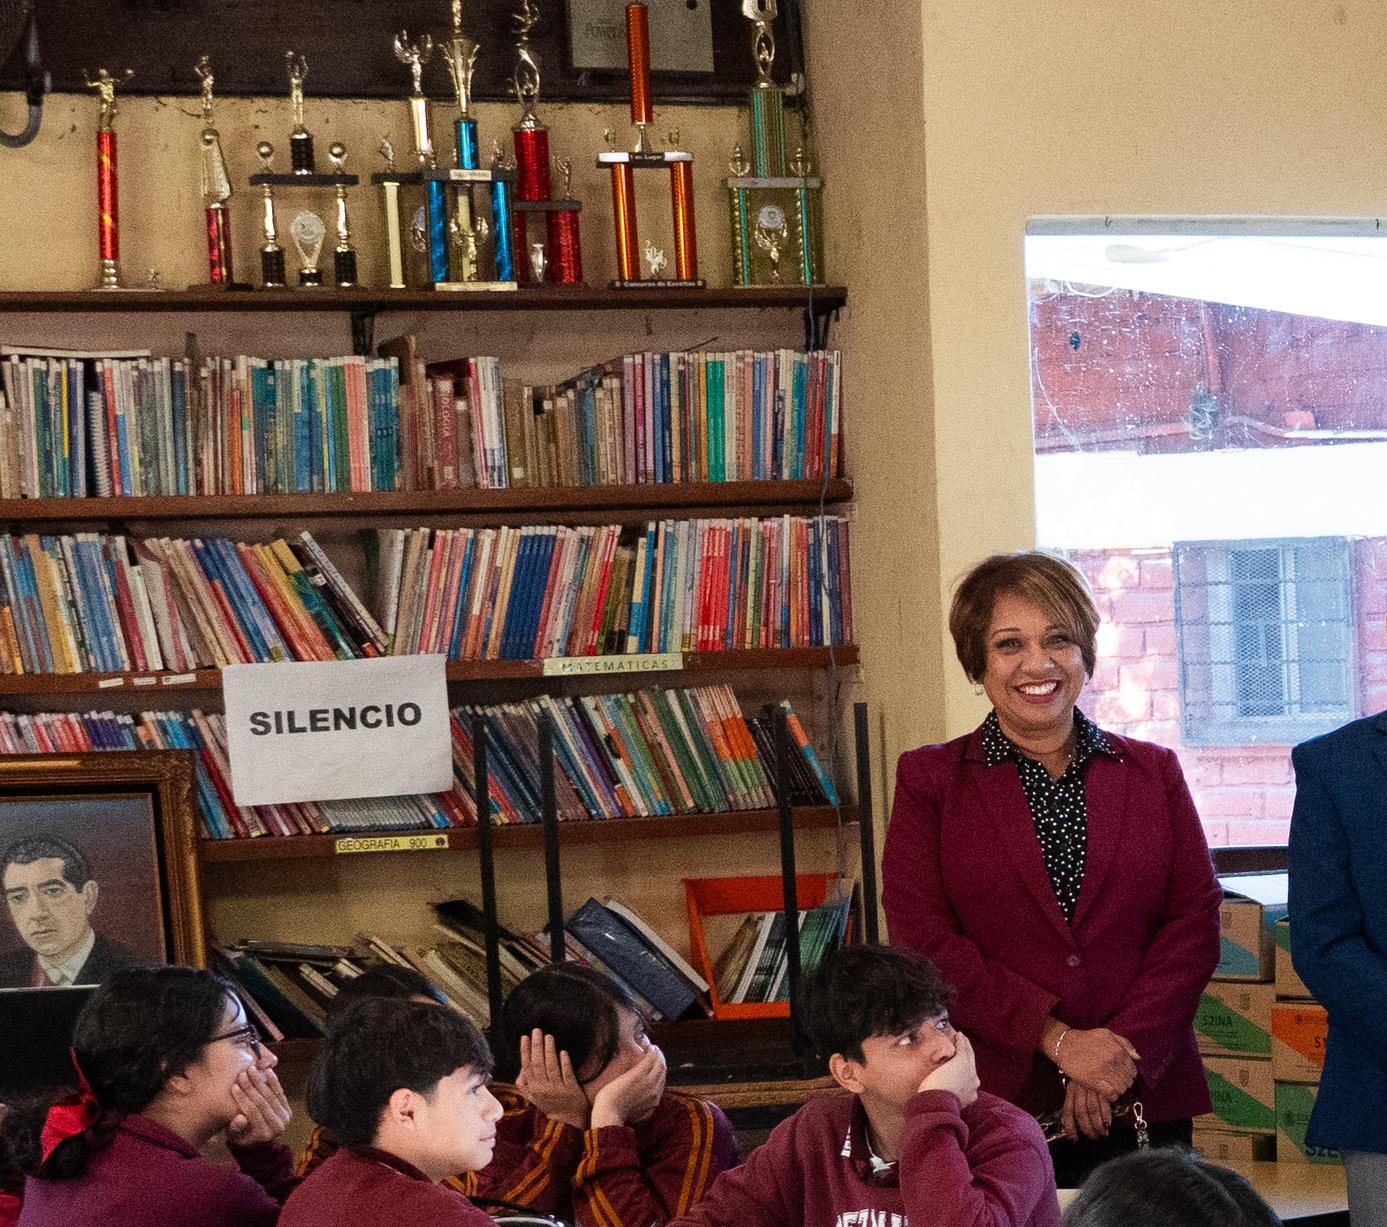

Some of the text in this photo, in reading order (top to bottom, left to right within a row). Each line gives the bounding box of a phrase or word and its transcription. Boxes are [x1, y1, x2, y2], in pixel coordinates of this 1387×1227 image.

[562, 659, 669, 673] MATEMATICAS
[249, 701, 422, 736] SILENCIO
[338, 838, 427, 851] GEOGRAFIA 900
